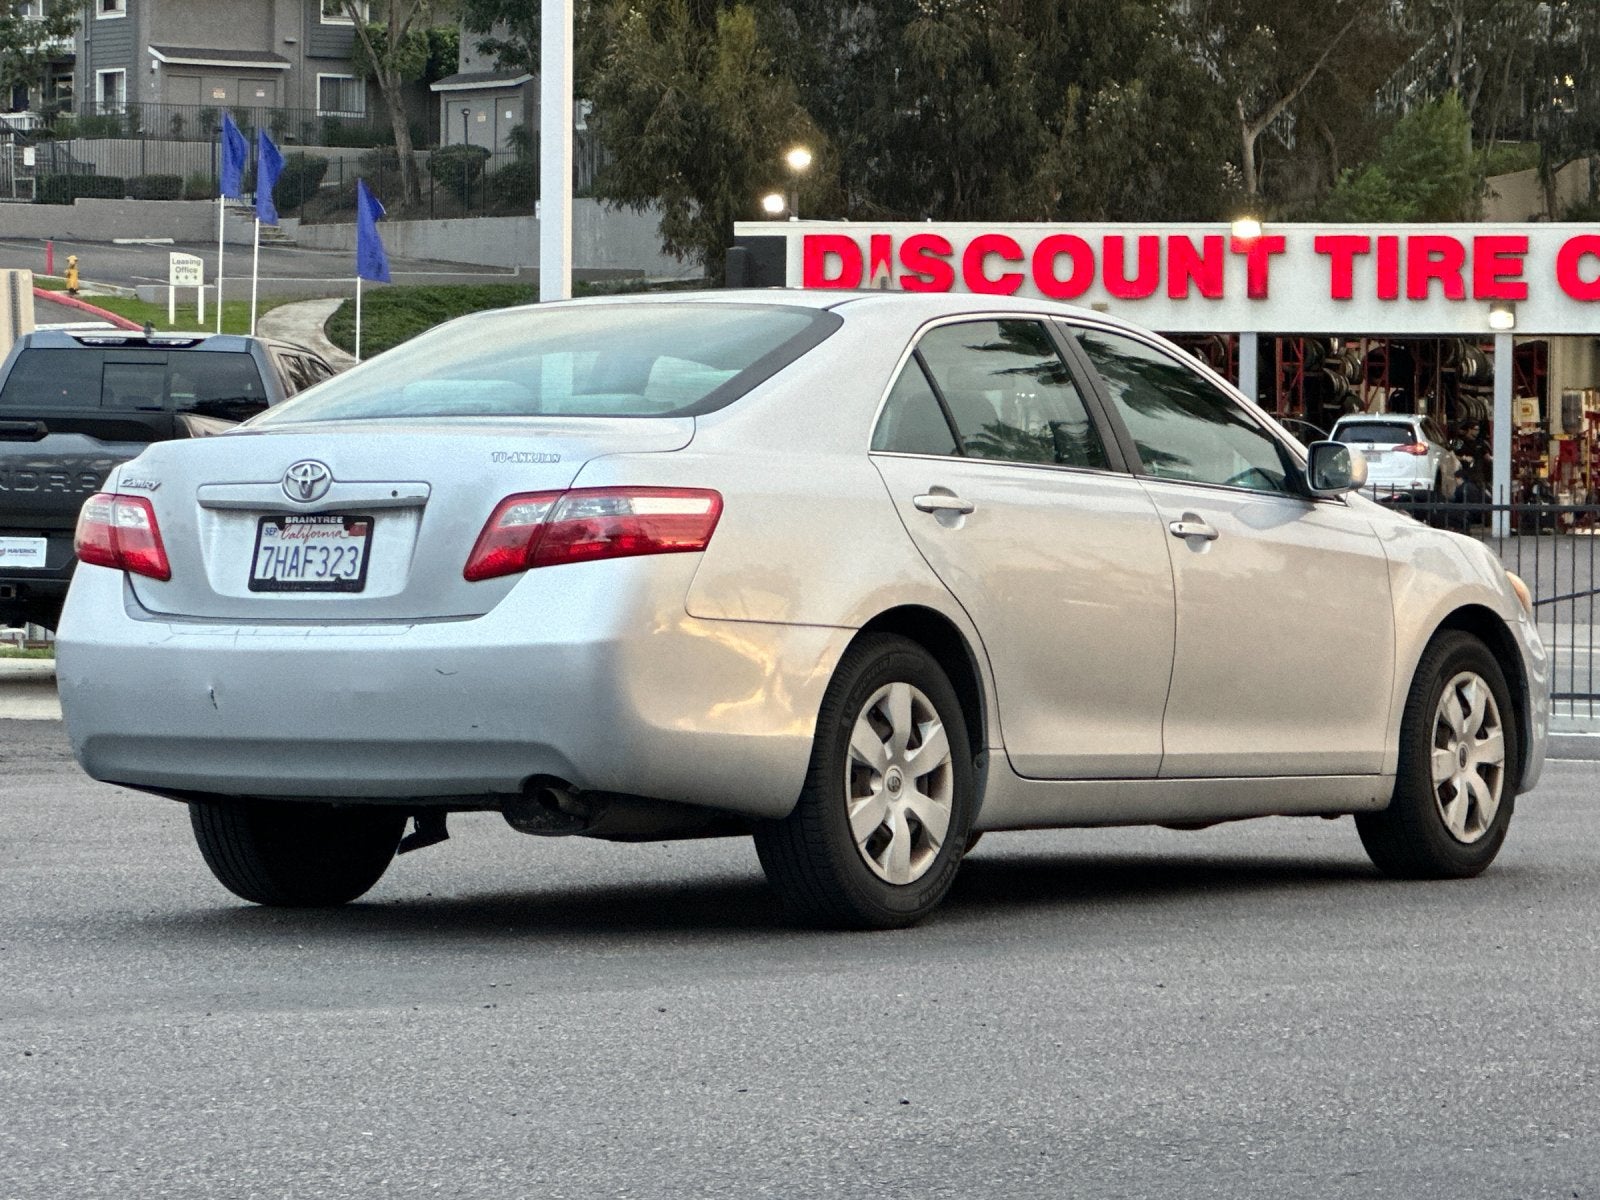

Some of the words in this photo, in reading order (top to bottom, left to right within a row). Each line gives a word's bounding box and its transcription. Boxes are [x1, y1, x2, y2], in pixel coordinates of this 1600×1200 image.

[172, 258, 201, 266] Leasing
[803, 233, 1286, 299] DISCOUNT
[1314, 235, 1529, 301] TIRE
[284, 516, 344, 524] BRAINTREE
[264, 526, 278, 536] SEP
[281, 523, 349, 545] California
[262, 545, 359, 577] 7HAF323
